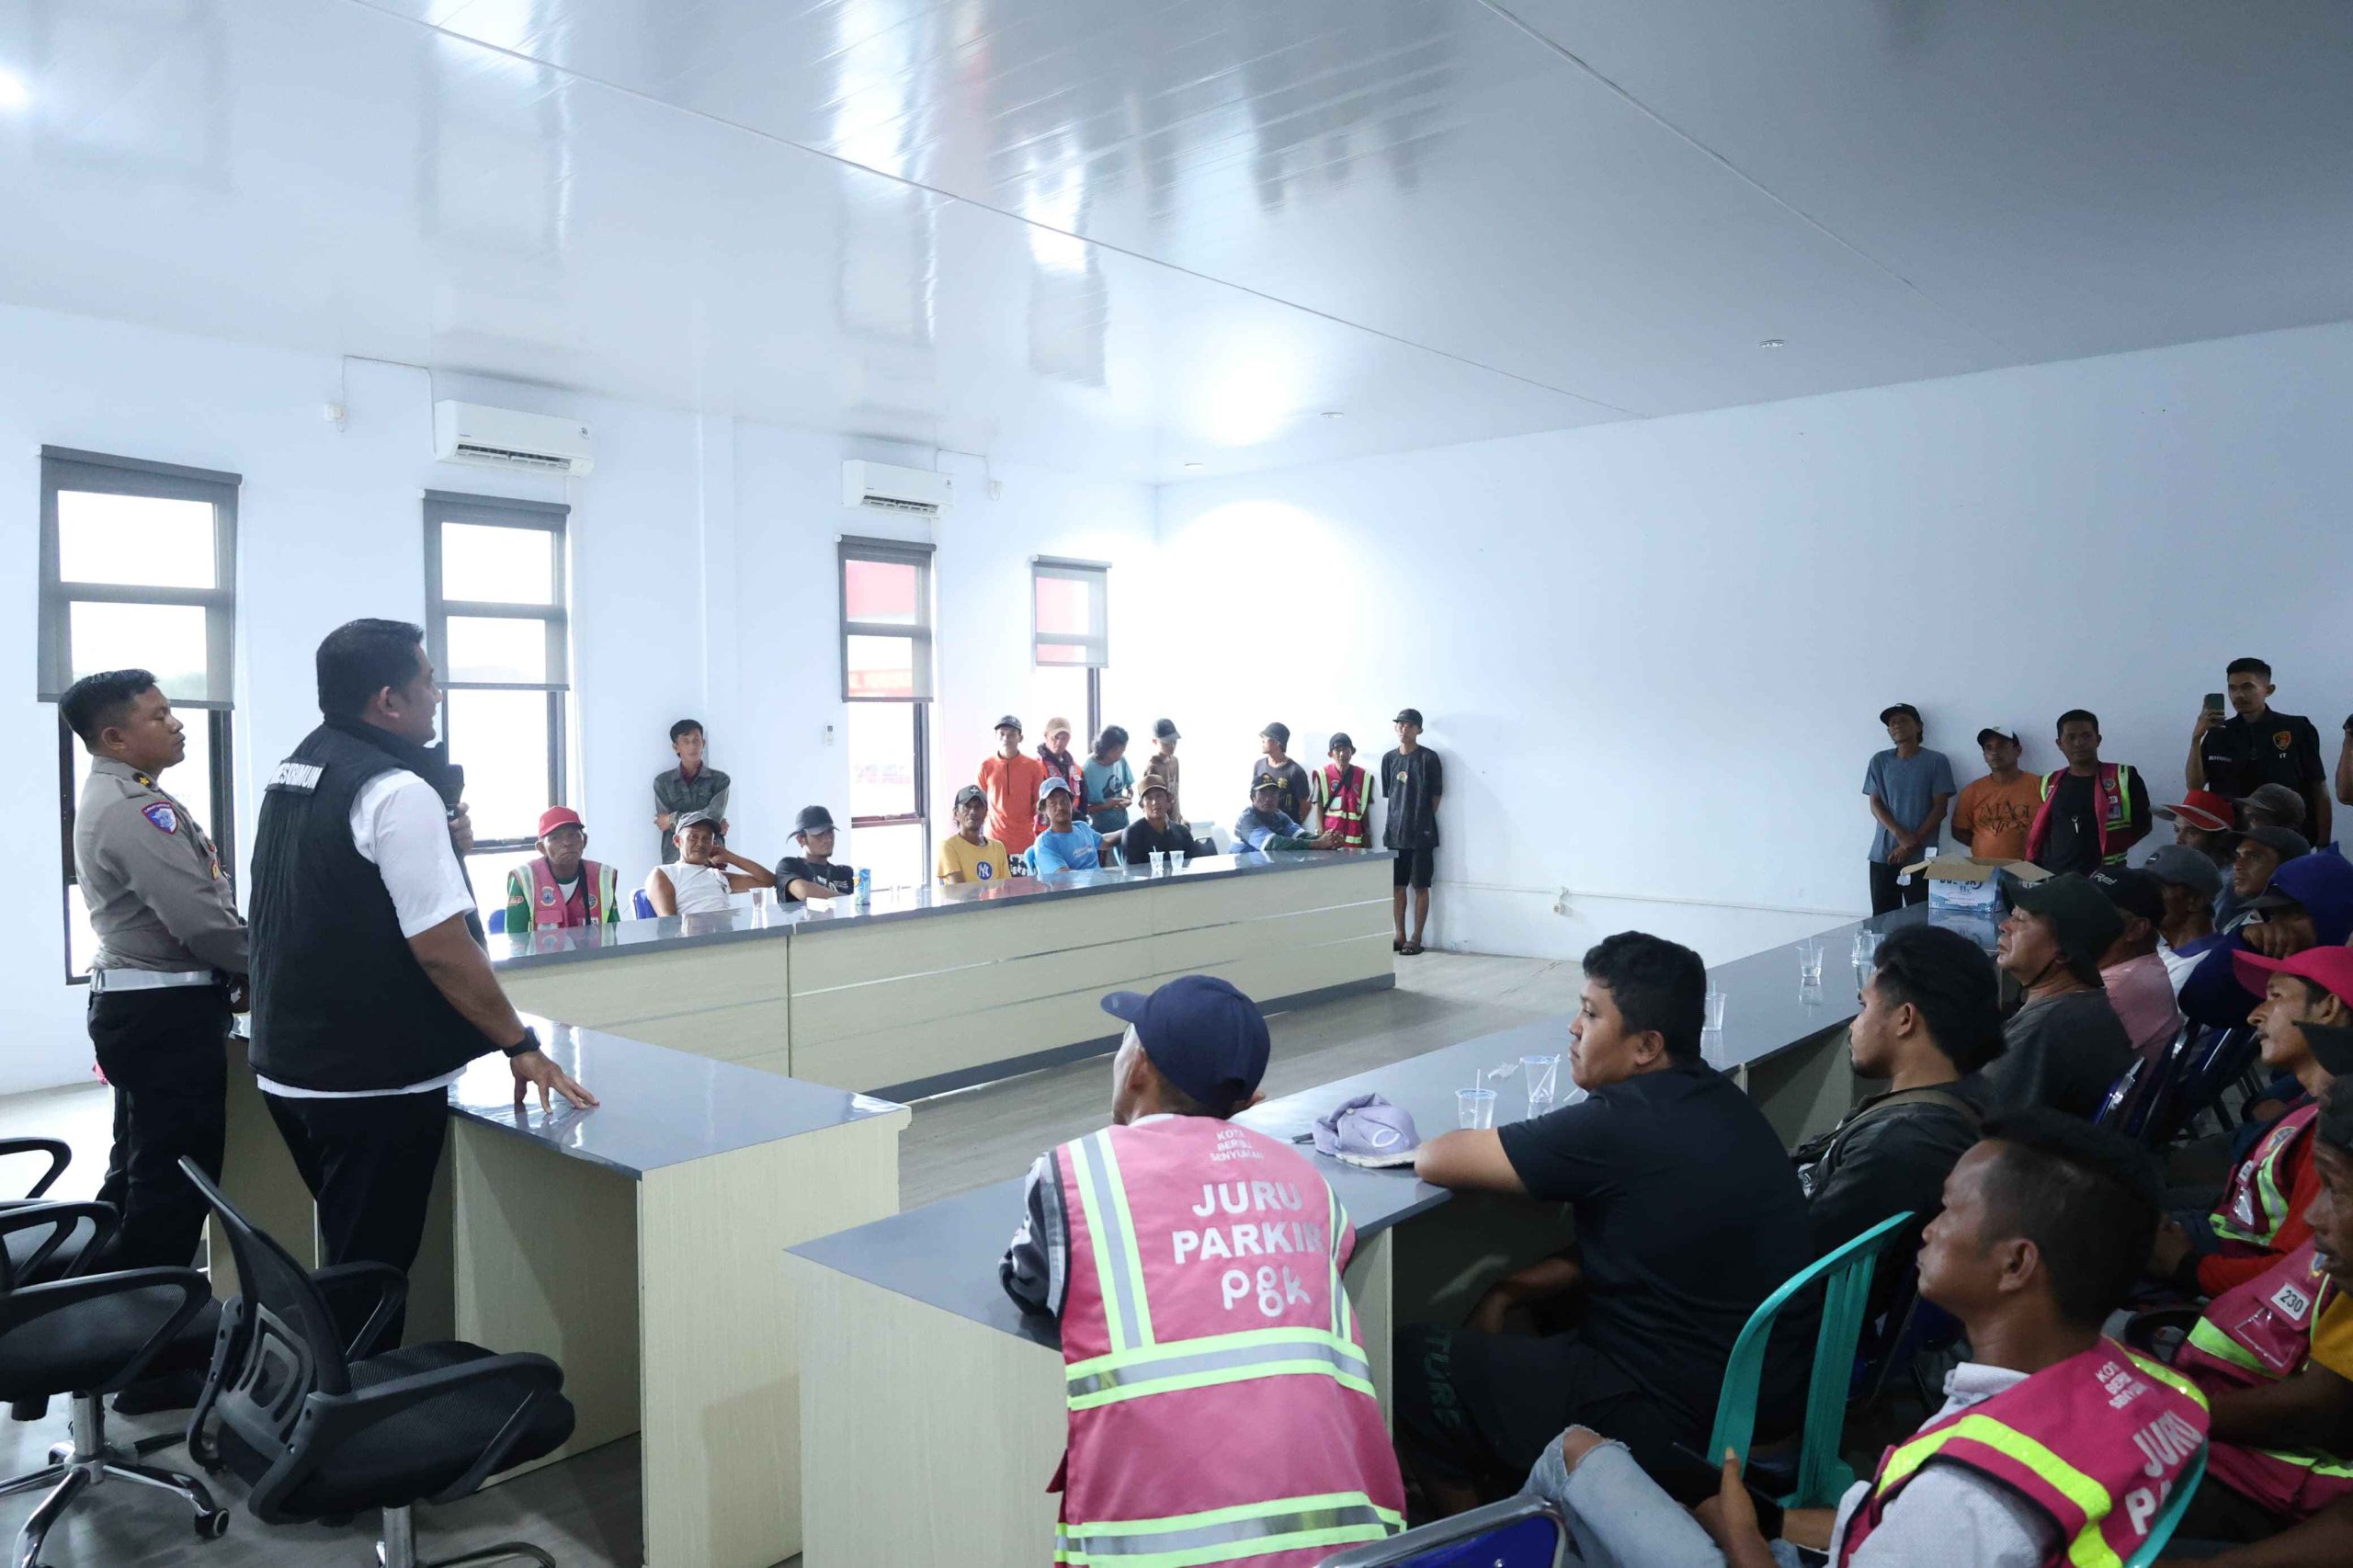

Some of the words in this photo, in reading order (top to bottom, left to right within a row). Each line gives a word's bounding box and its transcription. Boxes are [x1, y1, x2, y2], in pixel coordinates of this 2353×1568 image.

[1192, 1180, 1302, 1217] JURU
[1172, 1221, 1324, 1265] PARKIR
[2279, 1290, 2304, 1312] 230
[2132, 1410, 2204, 1478] JURU
